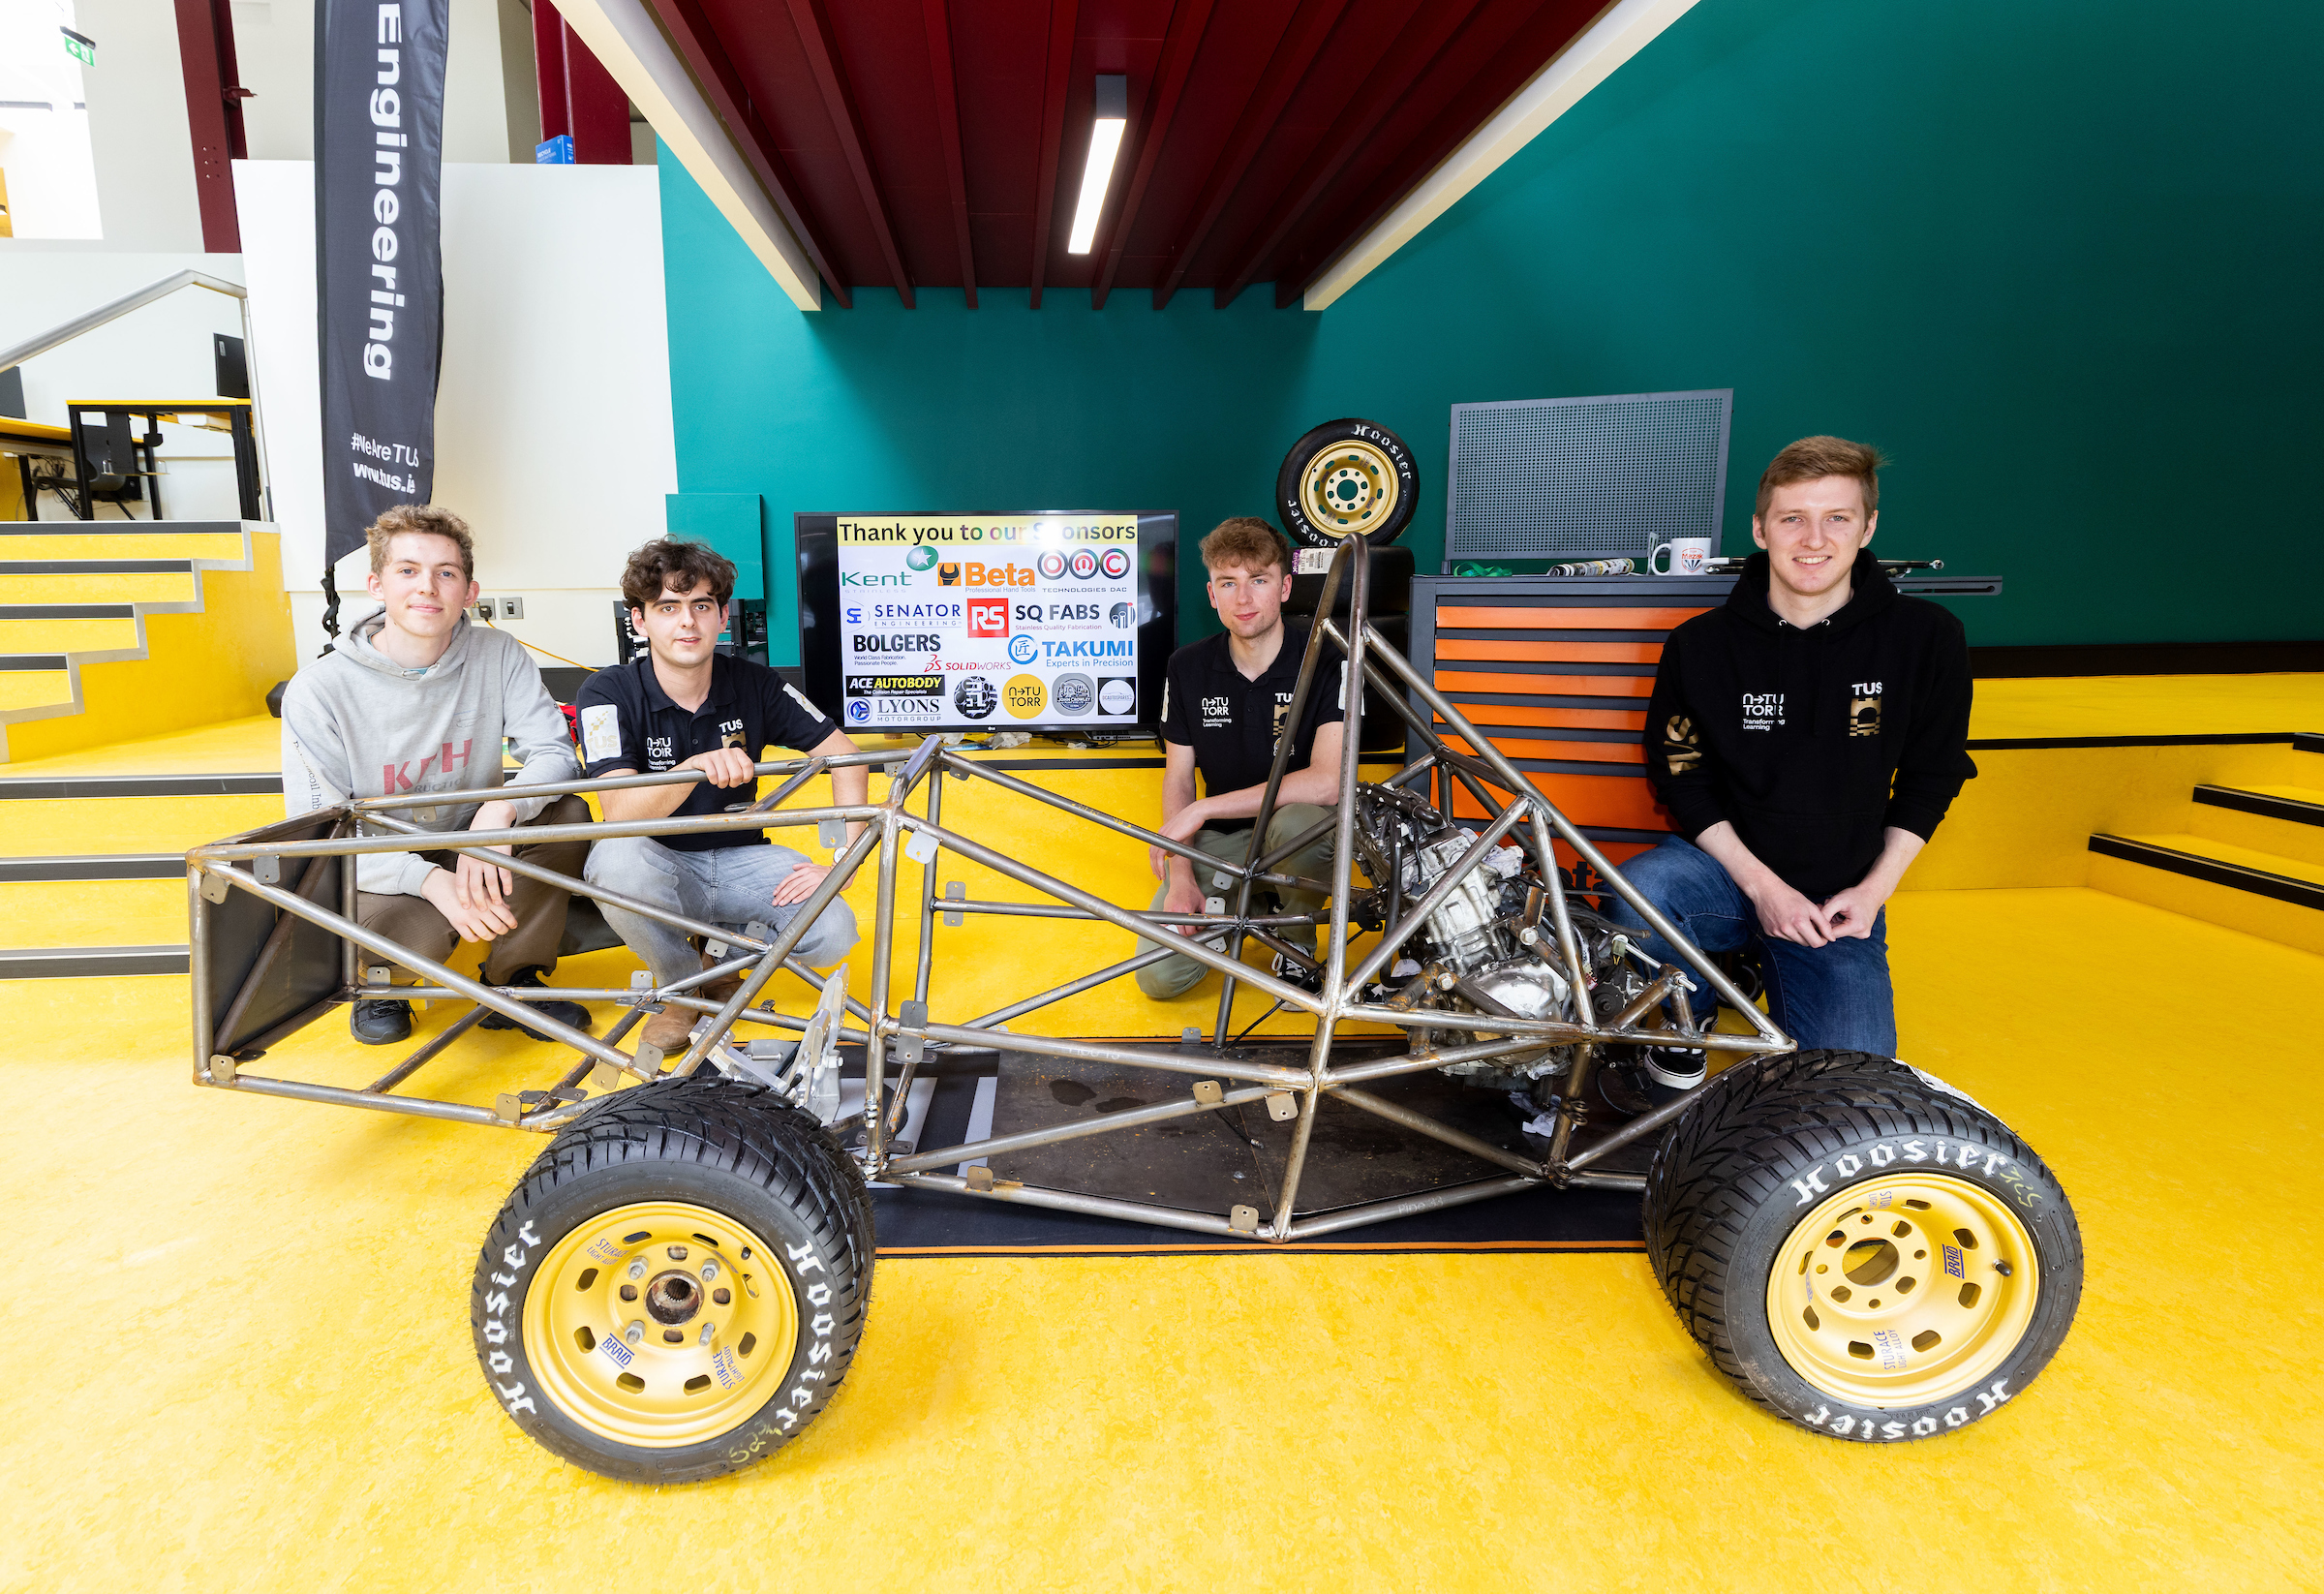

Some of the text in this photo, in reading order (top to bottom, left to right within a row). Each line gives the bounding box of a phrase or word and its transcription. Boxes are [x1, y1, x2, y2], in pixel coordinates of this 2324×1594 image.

[363, 3, 408, 381] Engineering
[1352, 424, 1412, 479] Hoosier
[839, 523, 907, 541] Thank
[913, 528, 953, 546] you
[960, 524, 983, 540] to
[990, 526, 1026, 540] our
[1288, 500, 1338, 547] oosier
[841, 571, 912, 586] Kent
[965, 562, 1036, 586] Beta
[874, 604, 961, 617] SENATOR
[971, 606, 1005, 630] RS
[1015, 604, 1100, 623] SQ FABS
[853, 634, 941, 652] BOLGERS
[1041, 641, 1133, 657] TAKUMI
[945, 662, 1011, 671] SOLIDWORKS
[1046, 658, 1133, 668] Experts in Precision
[849, 677, 942, 689] ACE AUTOBODY
[1851, 681, 1883, 696] TUS
[877, 699, 940, 713] LYONS
[1009, 697, 1041, 707] TORR
[1275, 693, 1294, 703] TU
[1202, 706, 1229, 716] TORR
[719, 719, 744, 733] TUS
[1790, 1139, 2008, 1208] Hoosier
[586, 1246, 604, 1262] LIGHT
[1946, 1245, 1961, 1278] BRAID
[483, 1219, 541, 1414] Hoosier
[776, 1240, 836, 1430] Hoosier
[601, 1337, 632, 1366] BRAID
[1874, 1330, 1896, 1370] STURACE
[1887, 1329, 1907, 1368] LIGHT ALLOY
[712, 1350, 736, 1390] STURACE
[723, 1345, 745, 1382] LIGHT ALLOY
[1803, 1378, 2012, 1440] Hoosier
